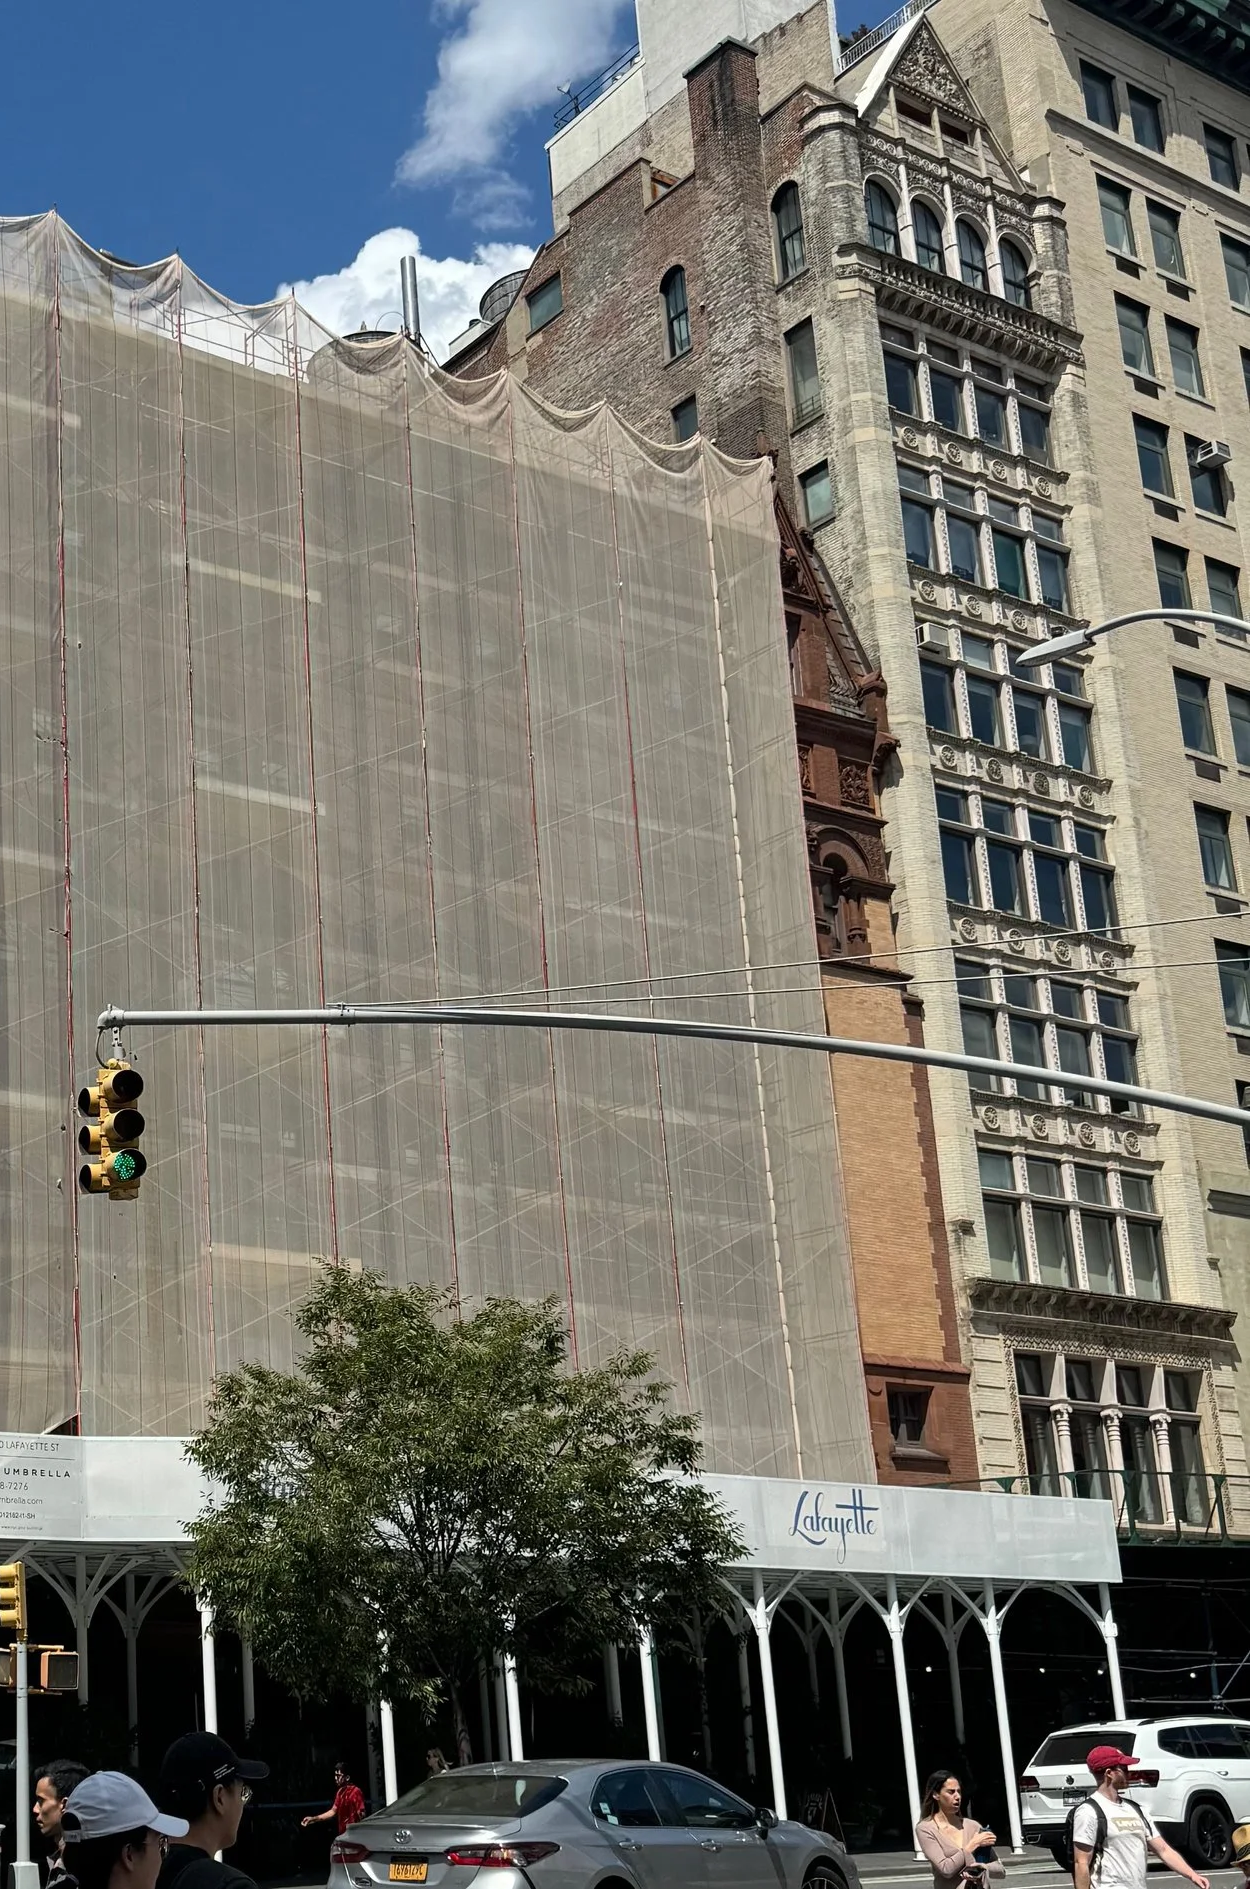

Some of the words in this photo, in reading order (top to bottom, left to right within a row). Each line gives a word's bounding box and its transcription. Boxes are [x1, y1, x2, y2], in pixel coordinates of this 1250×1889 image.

[6, 1441, 48, 1451] LAFAYETTE
[51, 1443, 59, 1451] ST
[4, 1468, 71, 1477] UMBRELLA
[788, 1489, 879, 1564] Lafayette
